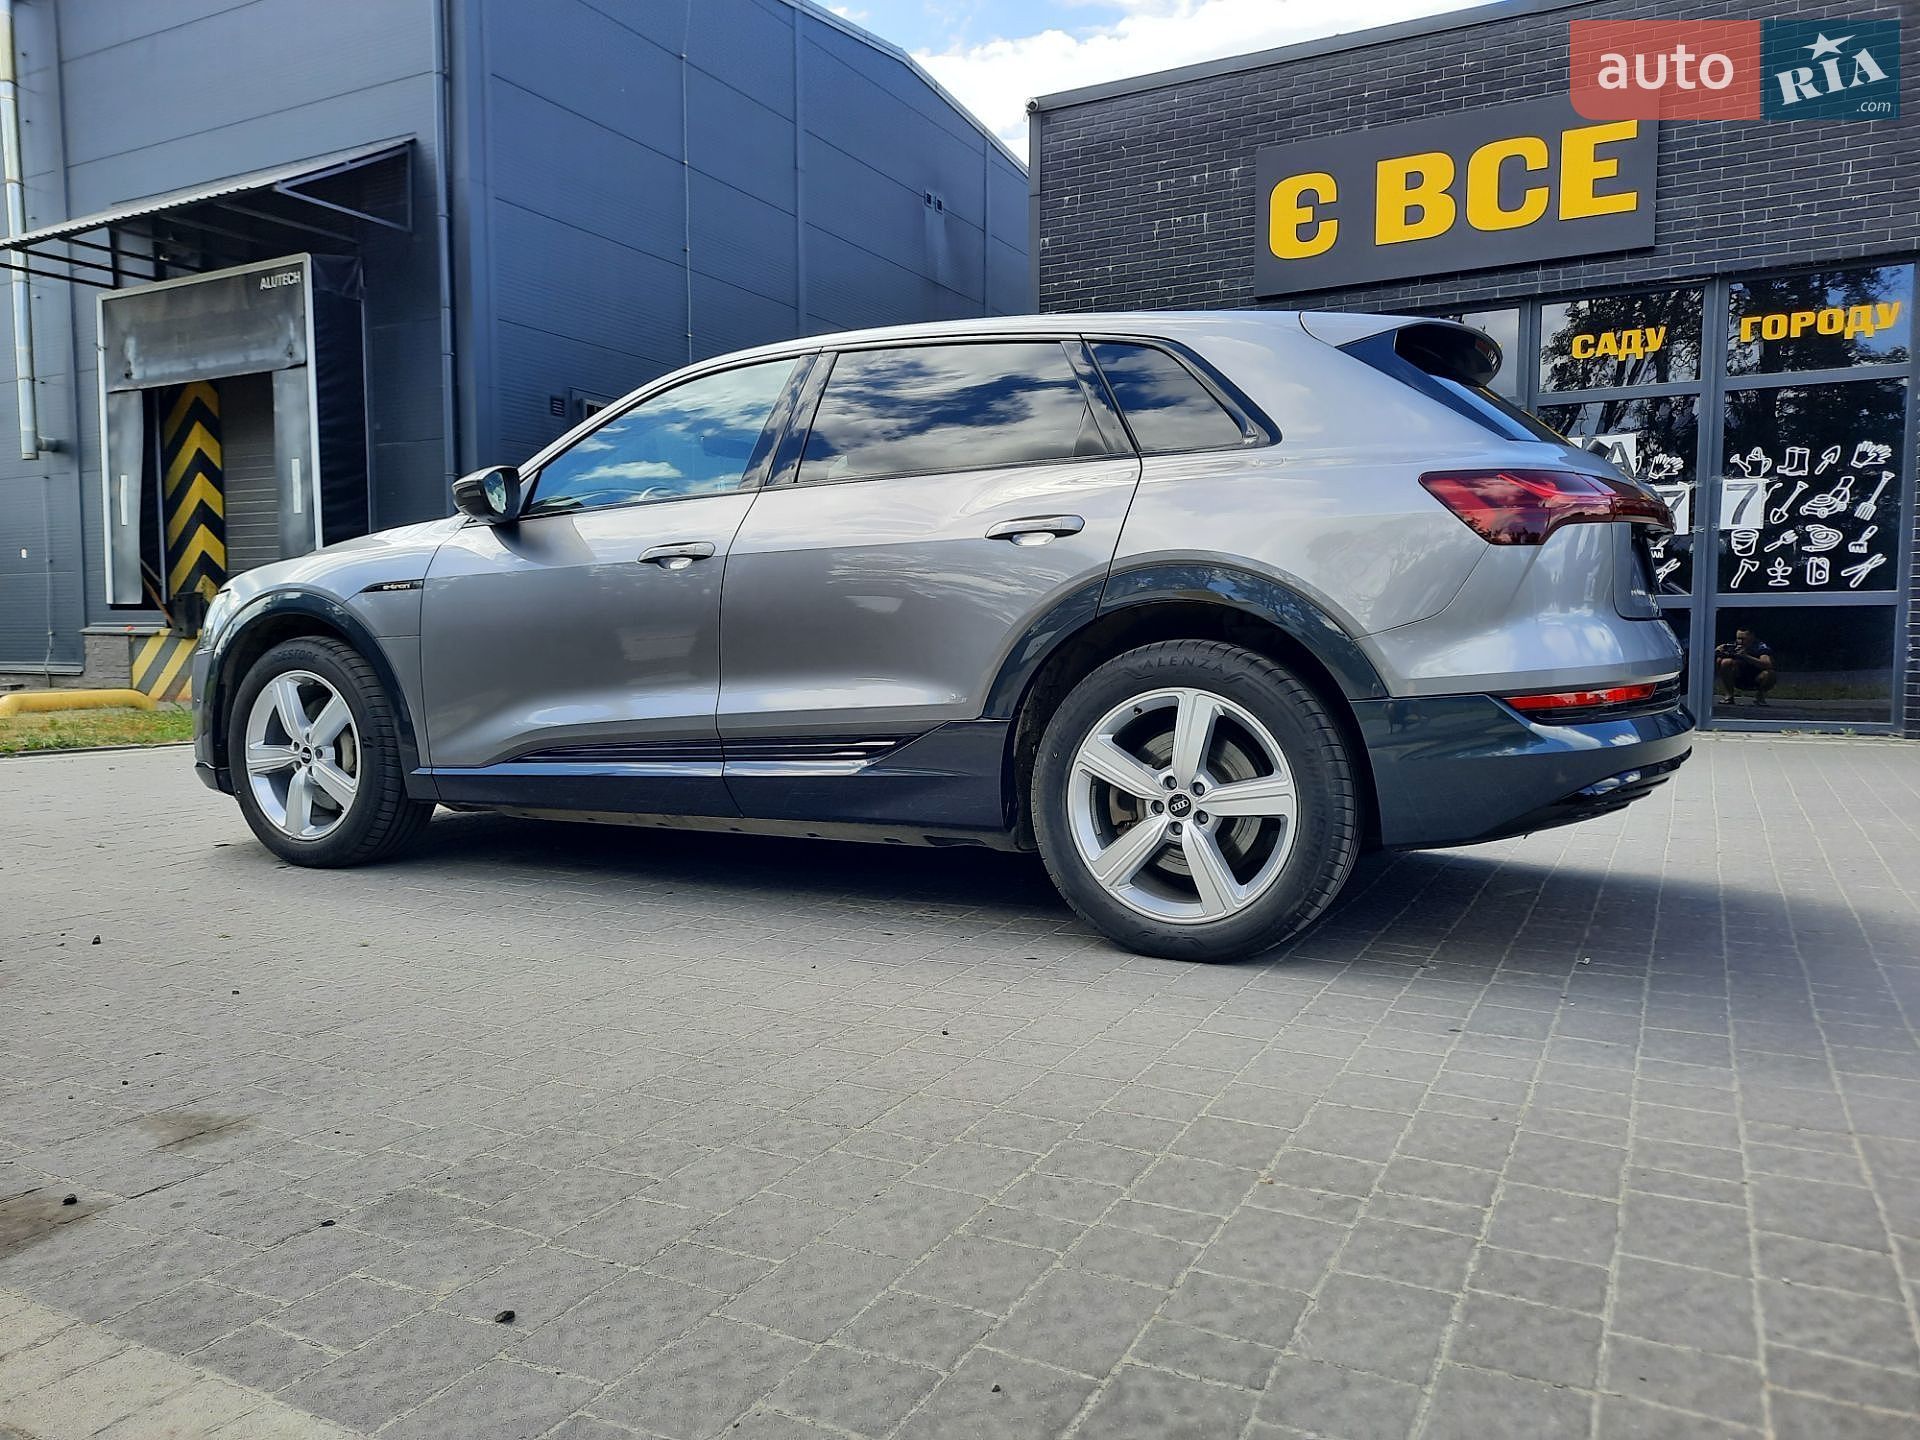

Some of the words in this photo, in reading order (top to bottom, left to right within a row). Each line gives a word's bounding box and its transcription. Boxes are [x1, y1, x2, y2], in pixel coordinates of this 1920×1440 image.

[1375, 119, 1638, 246] ВСЕ
[260, 271, 301, 290] ALUTECH
[1571, 326, 1667, 361] САДУ
[1740, 301, 1901, 343] ГОРОДУ
[1142, 655, 1224, 673] ALENZA
